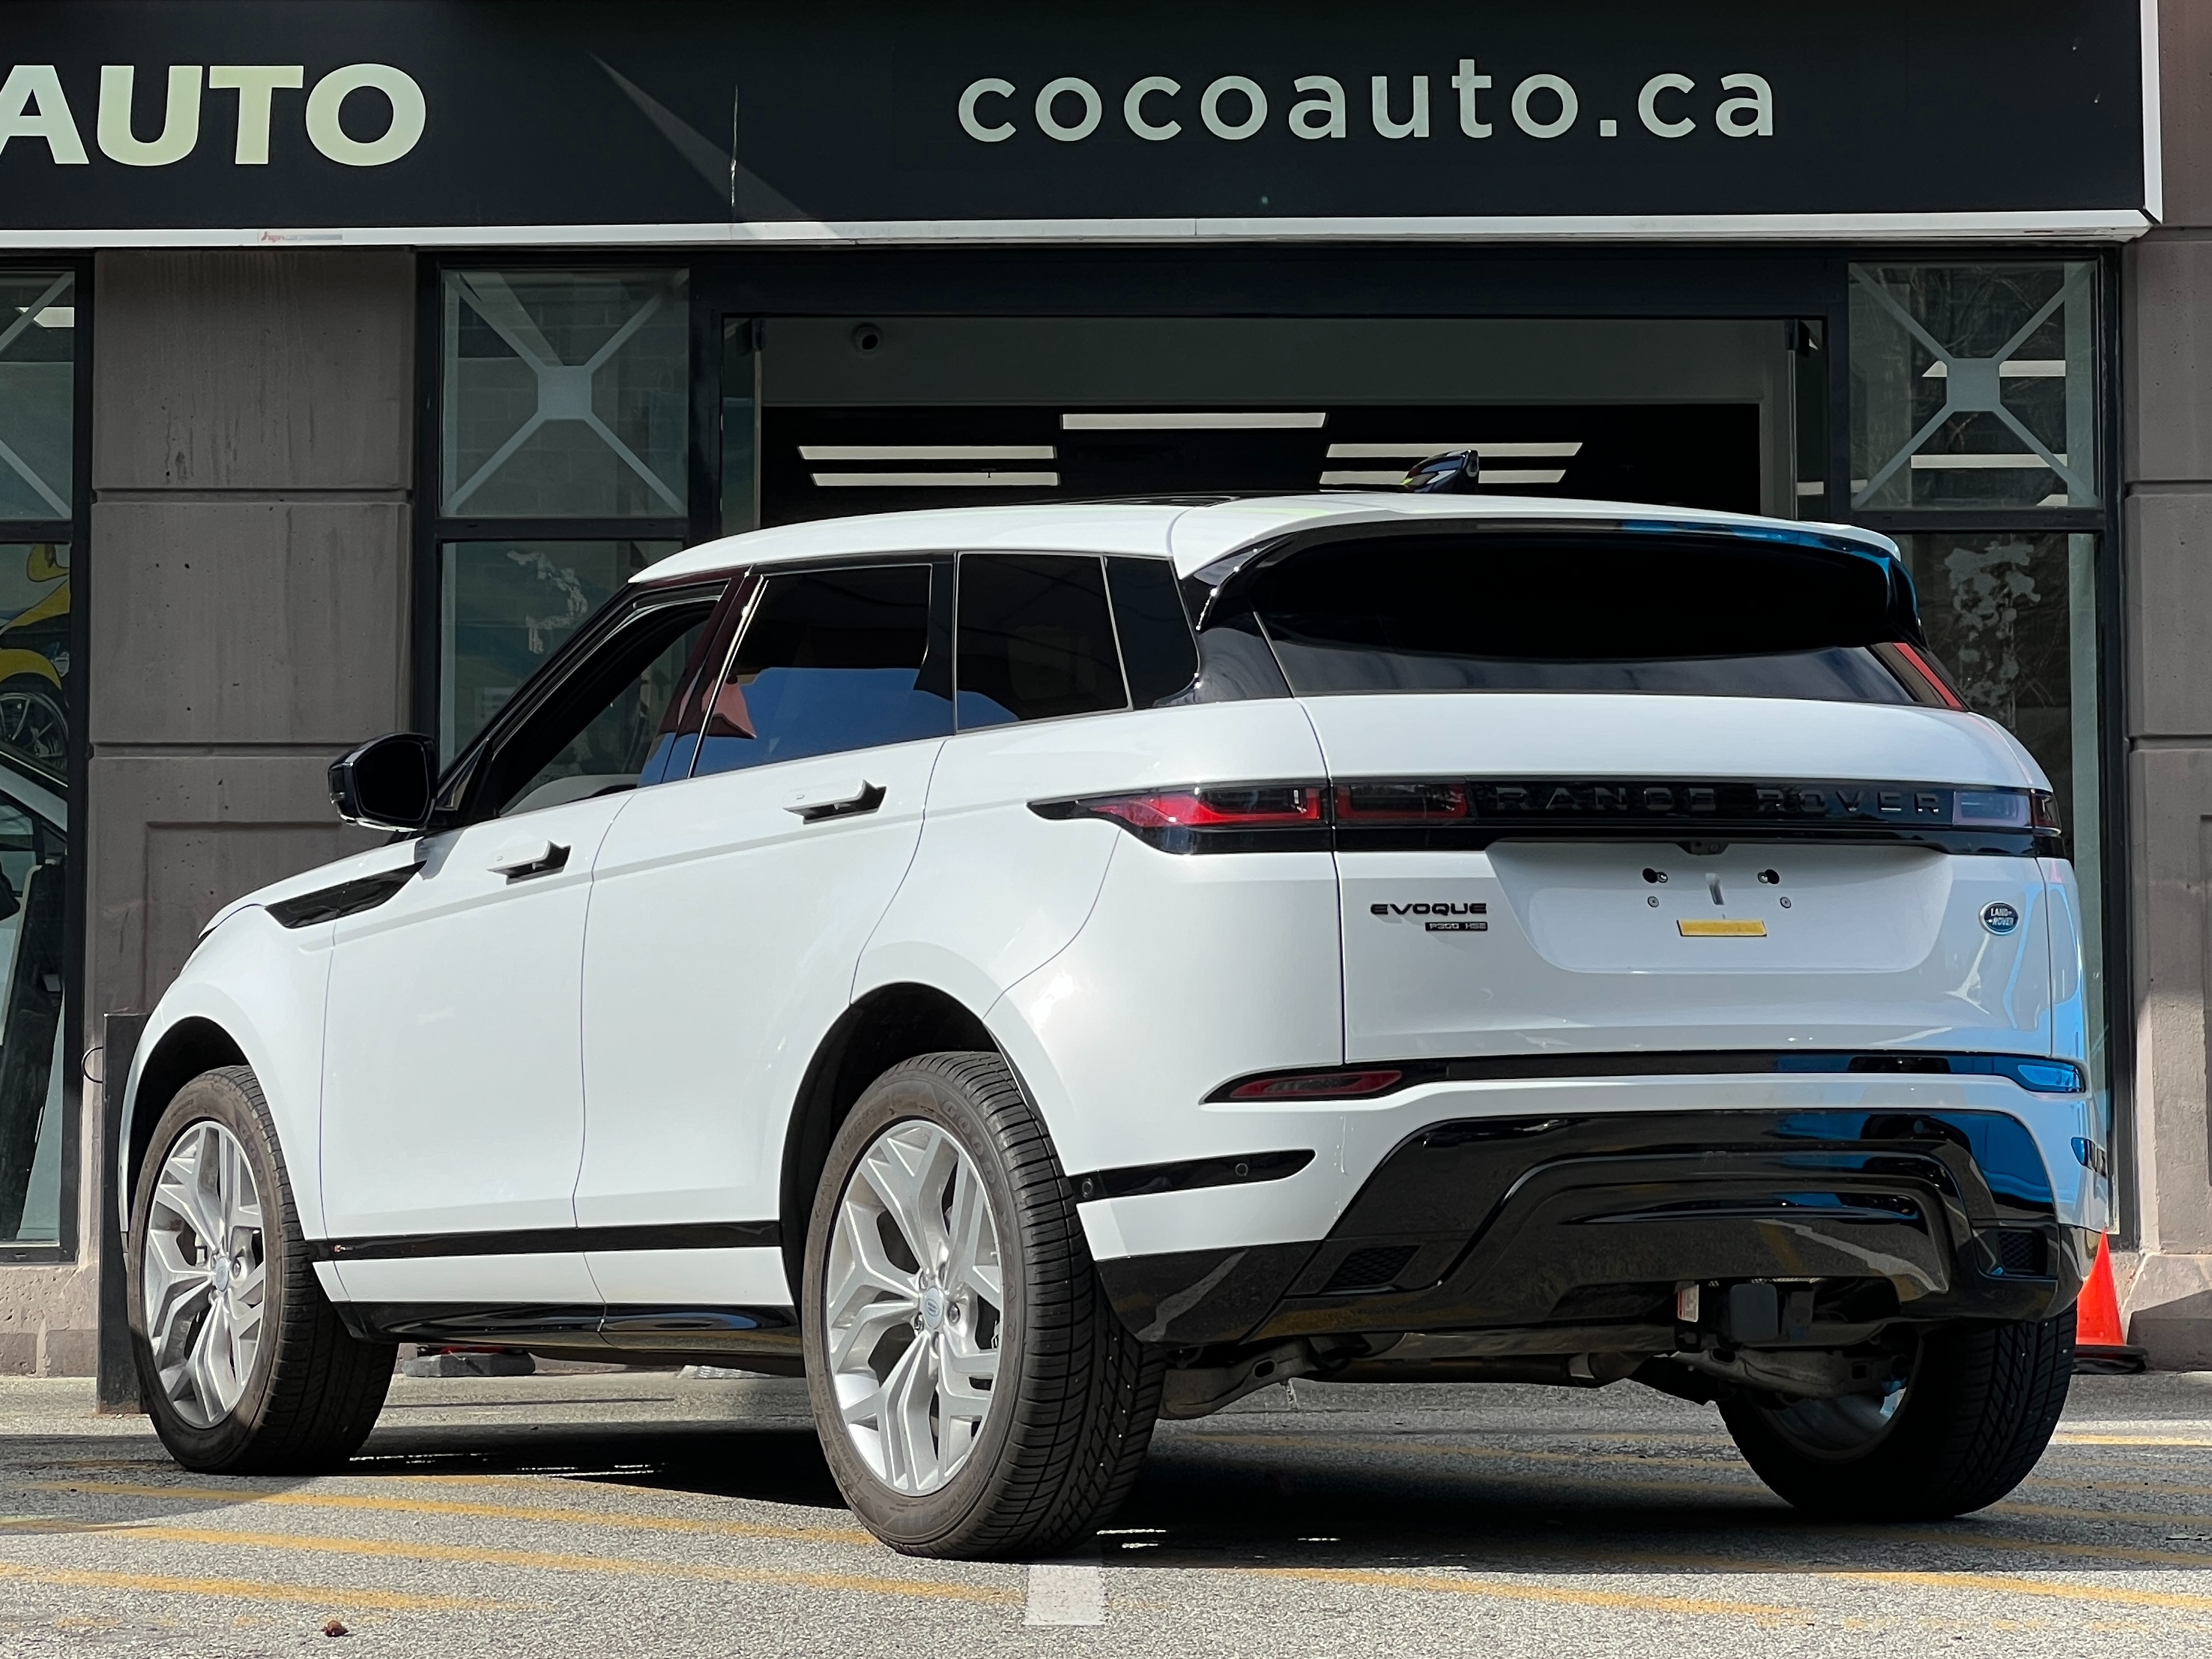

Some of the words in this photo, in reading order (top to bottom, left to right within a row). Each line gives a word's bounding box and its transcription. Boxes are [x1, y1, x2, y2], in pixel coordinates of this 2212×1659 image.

[958, 58, 1774, 142] cocoauto.ca
[0, 63, 426, 166] AUTO
[1496, 787, 1716, 811] RANGE
[1756, 788, 1939, 813] ROVER
[1370, 902, 1487, 916] EVOQUE
[1990, 907, 2008, 916] LAND
[1992, 917, 2014, 925] ROVER
